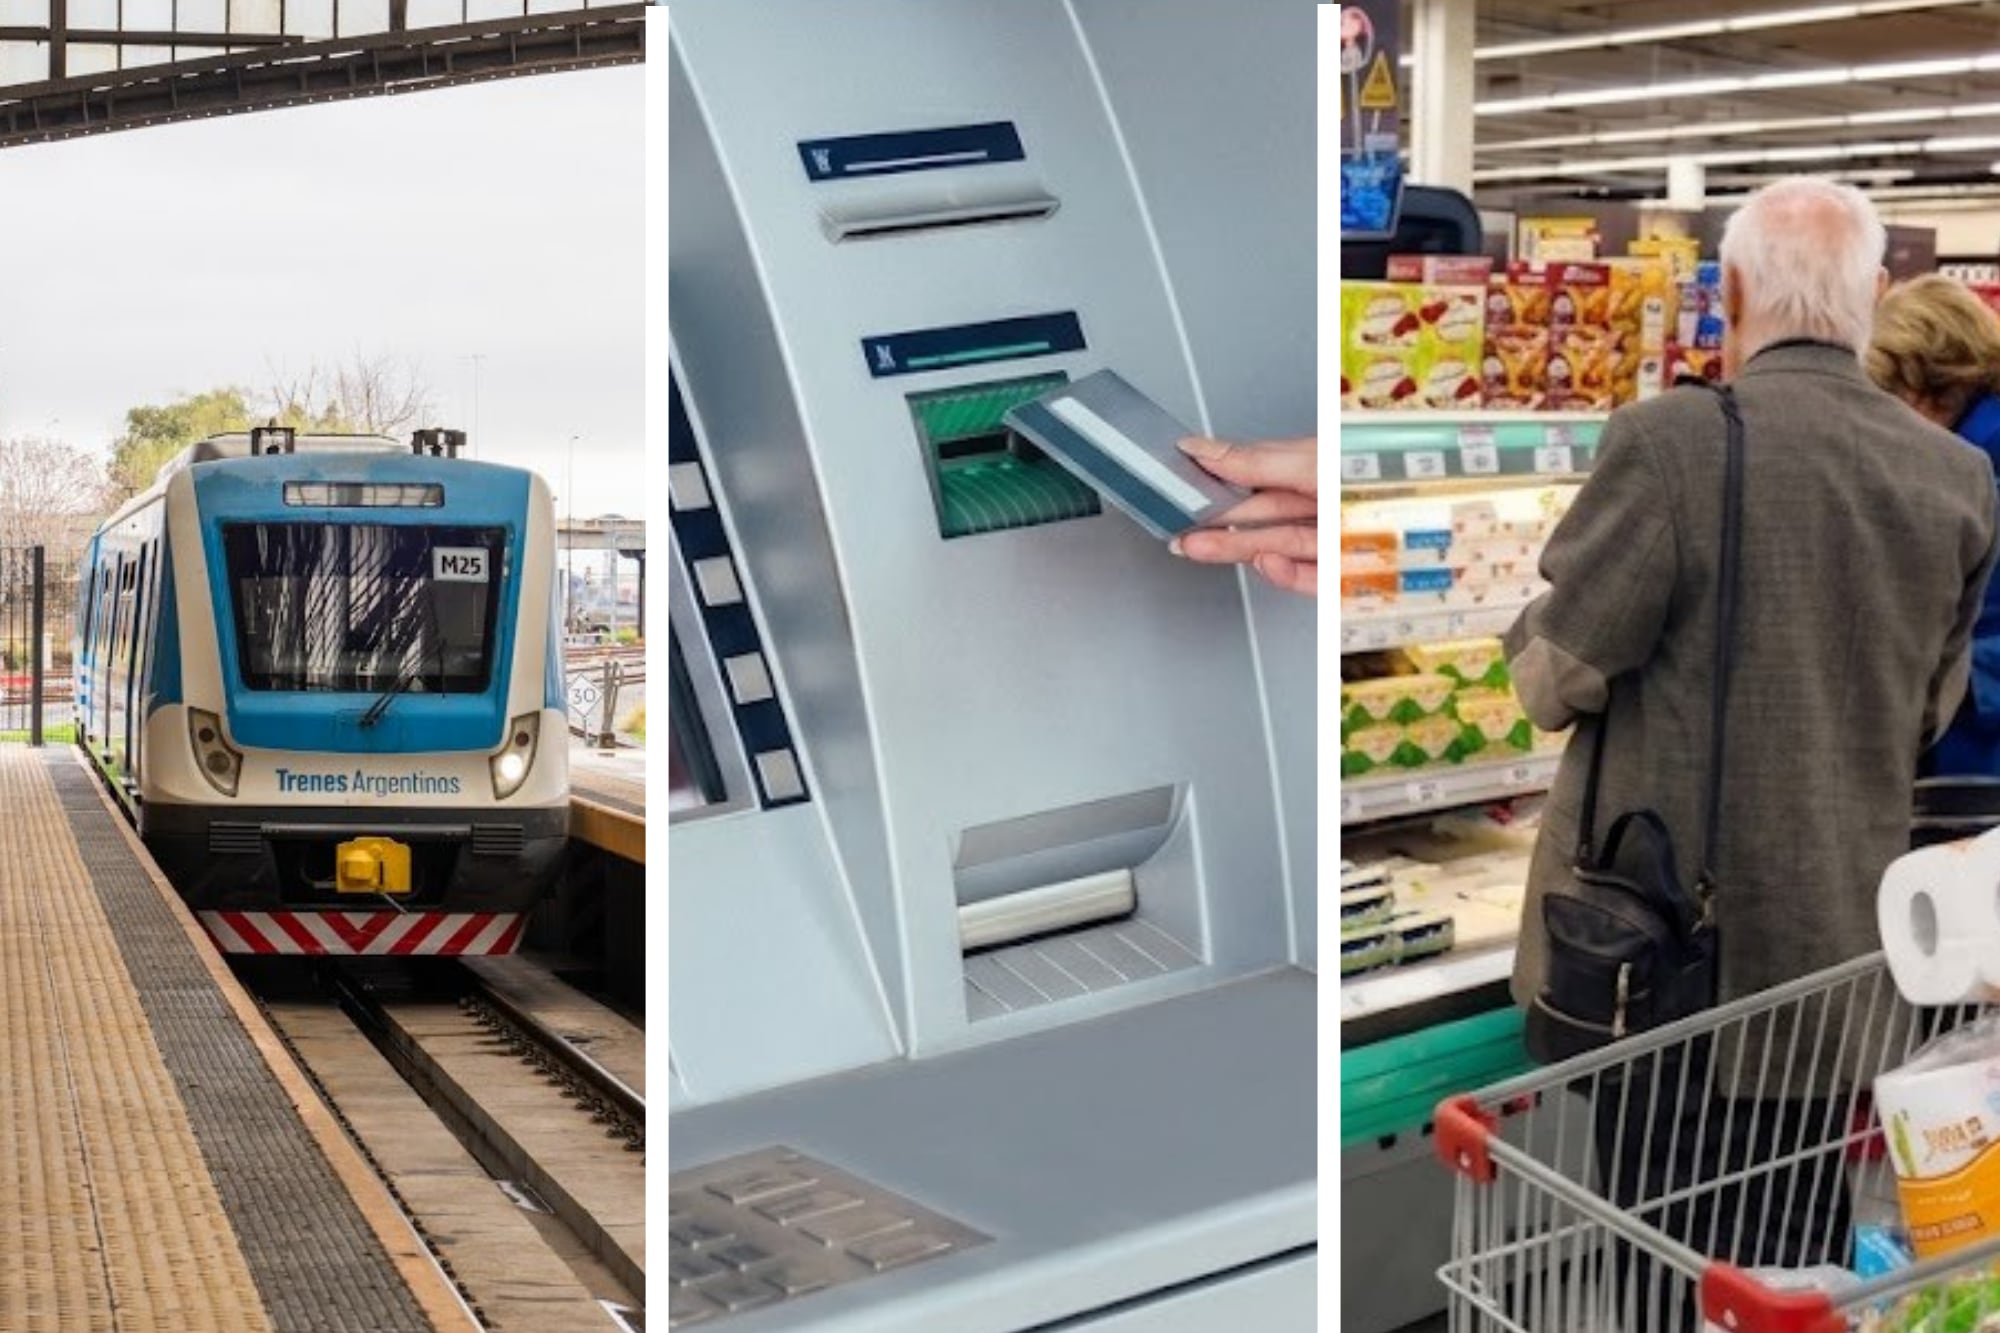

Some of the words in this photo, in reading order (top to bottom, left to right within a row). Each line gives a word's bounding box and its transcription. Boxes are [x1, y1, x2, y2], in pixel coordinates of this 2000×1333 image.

[441, 554, 481, 576] M25
[572, 687, 596, 705] 30
[275, 768, 348, 793] Trenes
[351, 769, 461, 797] Argentinos
